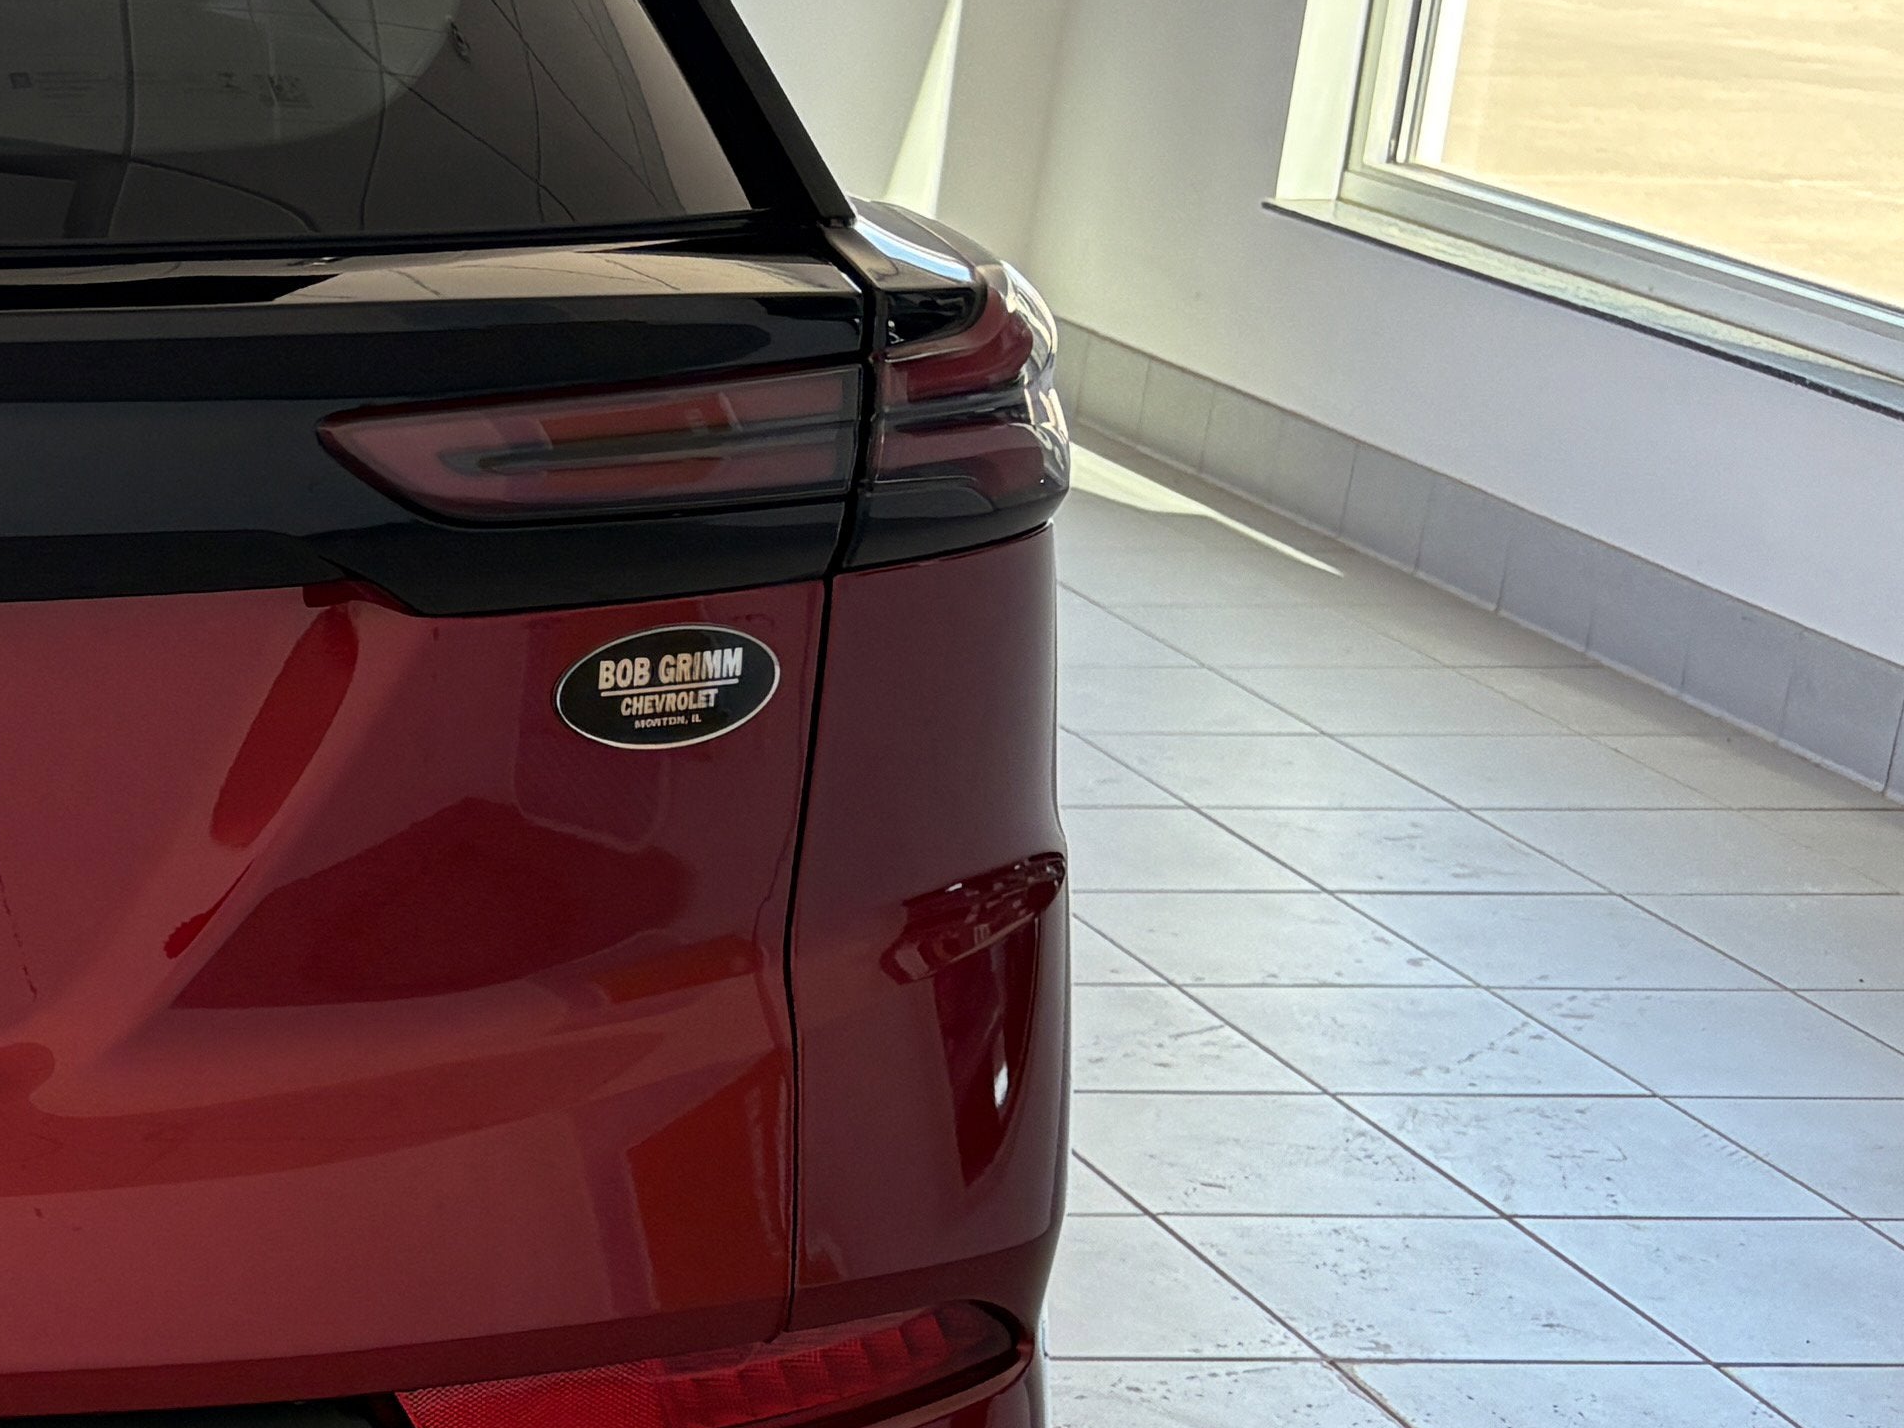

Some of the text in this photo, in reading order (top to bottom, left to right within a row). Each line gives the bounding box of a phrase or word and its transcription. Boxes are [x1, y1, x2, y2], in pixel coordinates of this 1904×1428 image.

[597, 646, 743, 690] BOB GRIMM
[620, 687, 719, 716] CHEVROLET
[691, 713, 702, 723] IL
